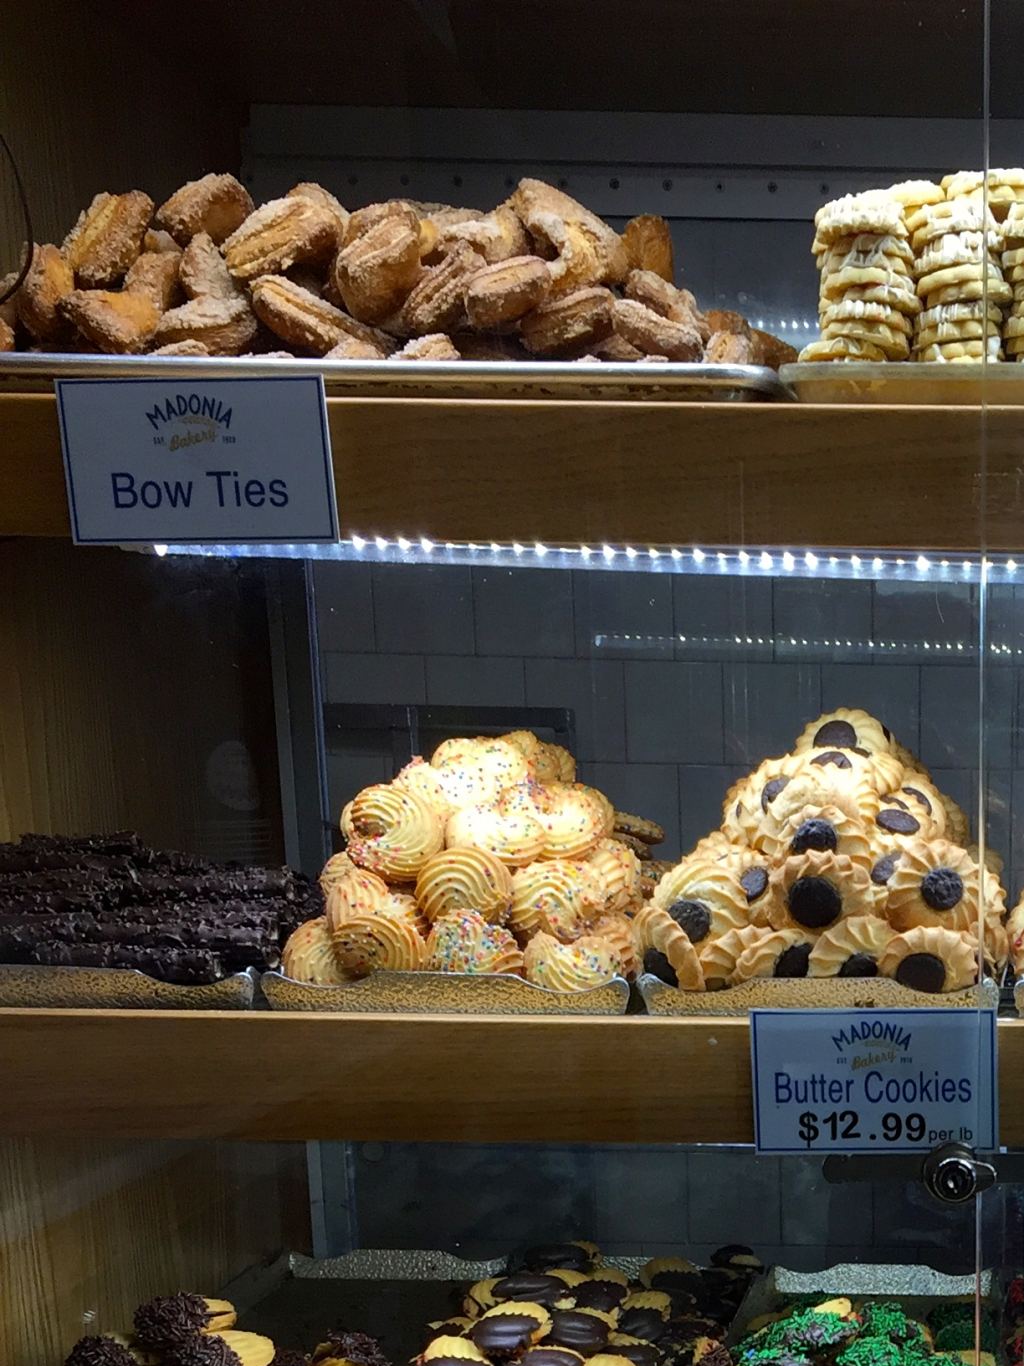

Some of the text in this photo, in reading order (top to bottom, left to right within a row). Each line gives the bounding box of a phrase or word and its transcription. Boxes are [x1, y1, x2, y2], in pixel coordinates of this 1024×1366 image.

[146, 393, 233, 430] MADONIA
[168, 430, 218, 452] Bakery
[111, 471, 289, 509] Bow Ties
[832, 1021, 912, 1052] MADONIA
[851, 1050, 898, 1071] Bakery
[774, 1070, 972, 1105] Butter Cookies
[798, 1110, 973, 1148] $12.99 per lb
